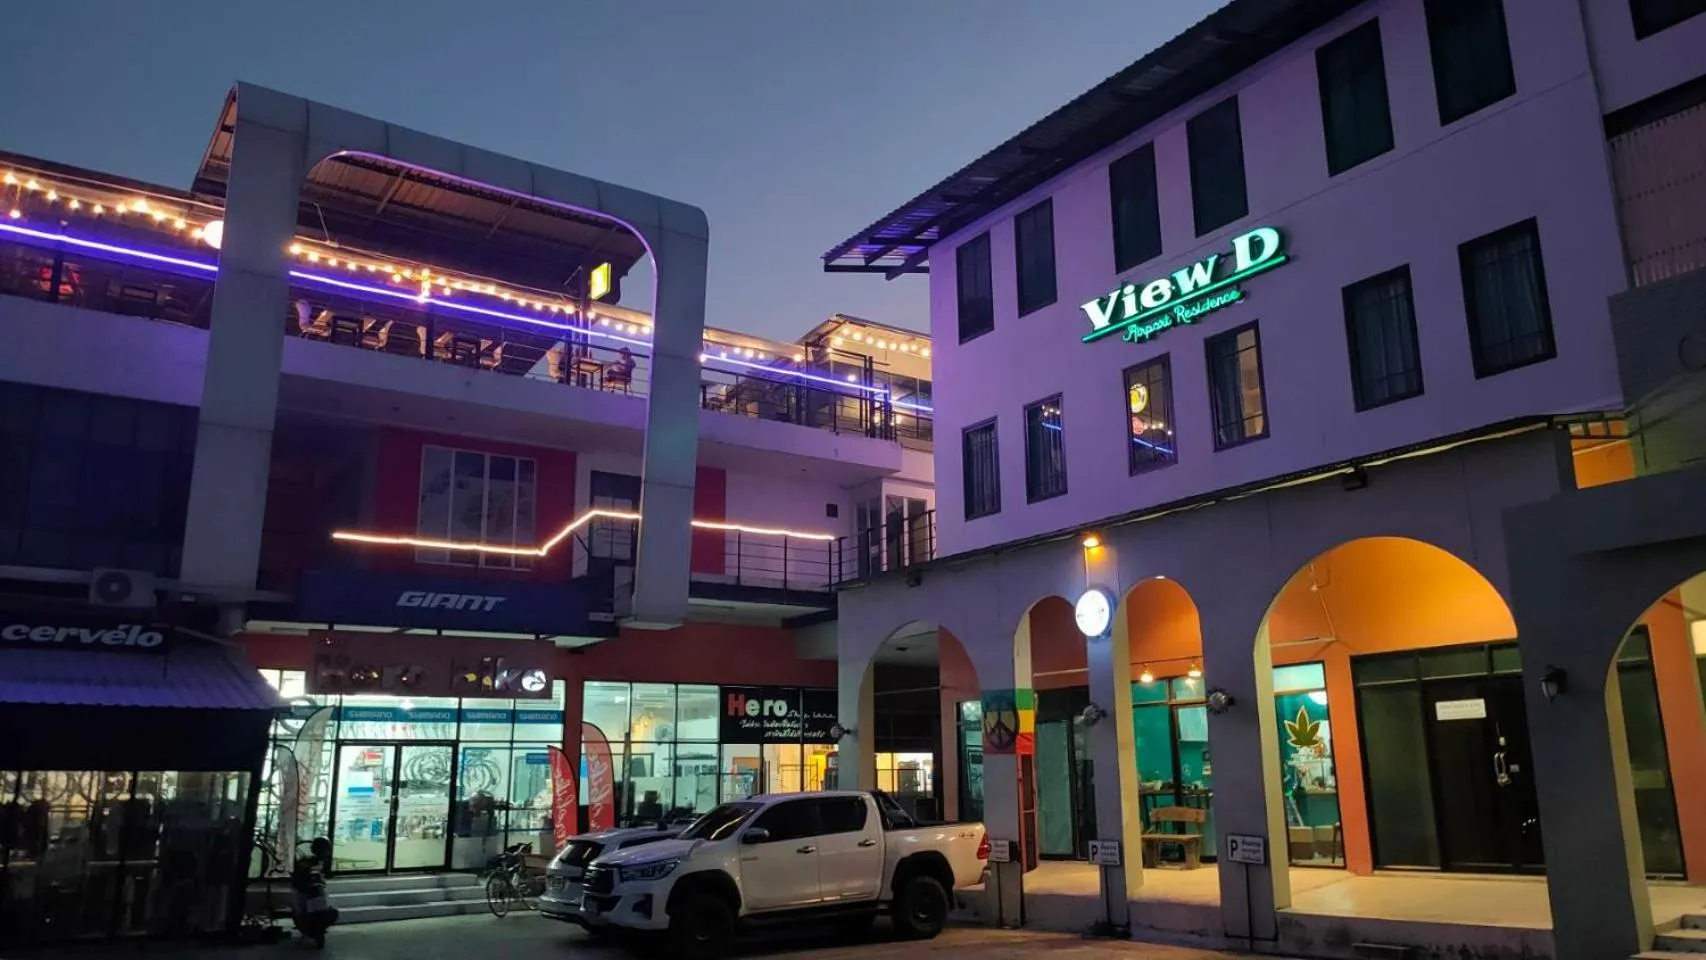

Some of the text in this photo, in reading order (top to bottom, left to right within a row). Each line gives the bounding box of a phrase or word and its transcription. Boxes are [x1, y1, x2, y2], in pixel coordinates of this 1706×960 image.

[1081, 226, 1281, 331] View D
[1122, 289, 1241, 343] Airport Residence
[396, 590, 508, 612] GIANT
[1, 623, 164, 648] cervélo
[728, 694, 788, 717] Hero
[1231, 839, 1238, 859] P
